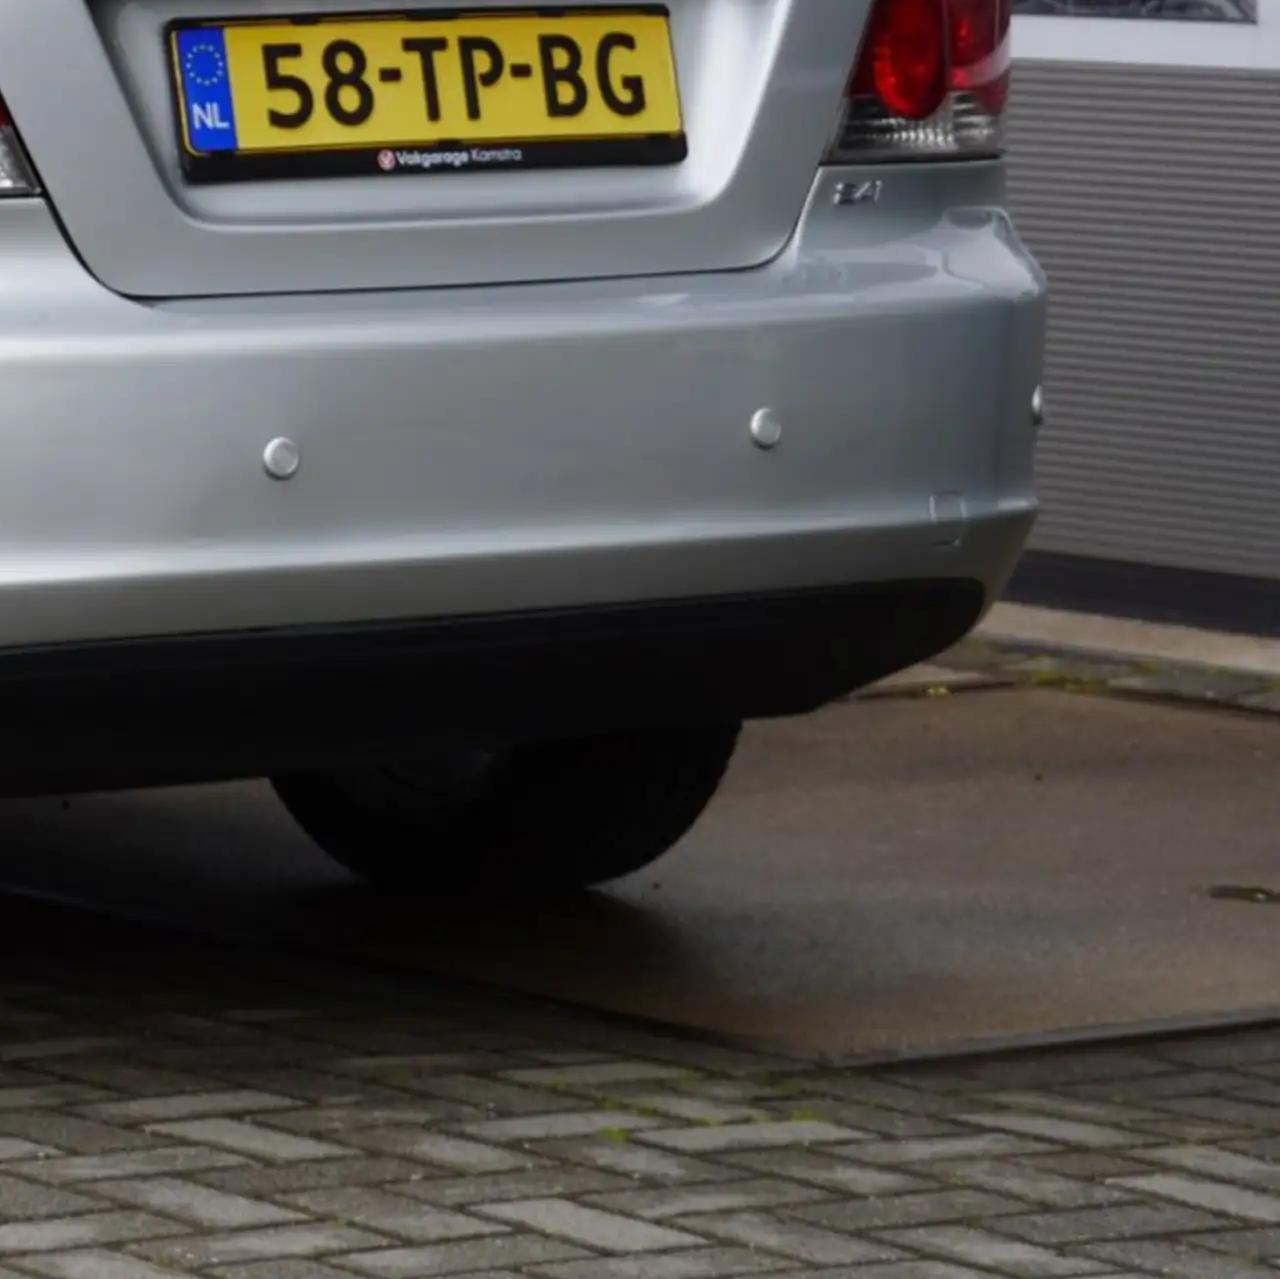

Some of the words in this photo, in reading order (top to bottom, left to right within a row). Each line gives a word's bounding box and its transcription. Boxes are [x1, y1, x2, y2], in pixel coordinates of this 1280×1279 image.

[260, 31, 647, 129] 58-TP-BG
[191, 102, 230, 130] NL
[395, 150, 470, 168] Vakgarage
